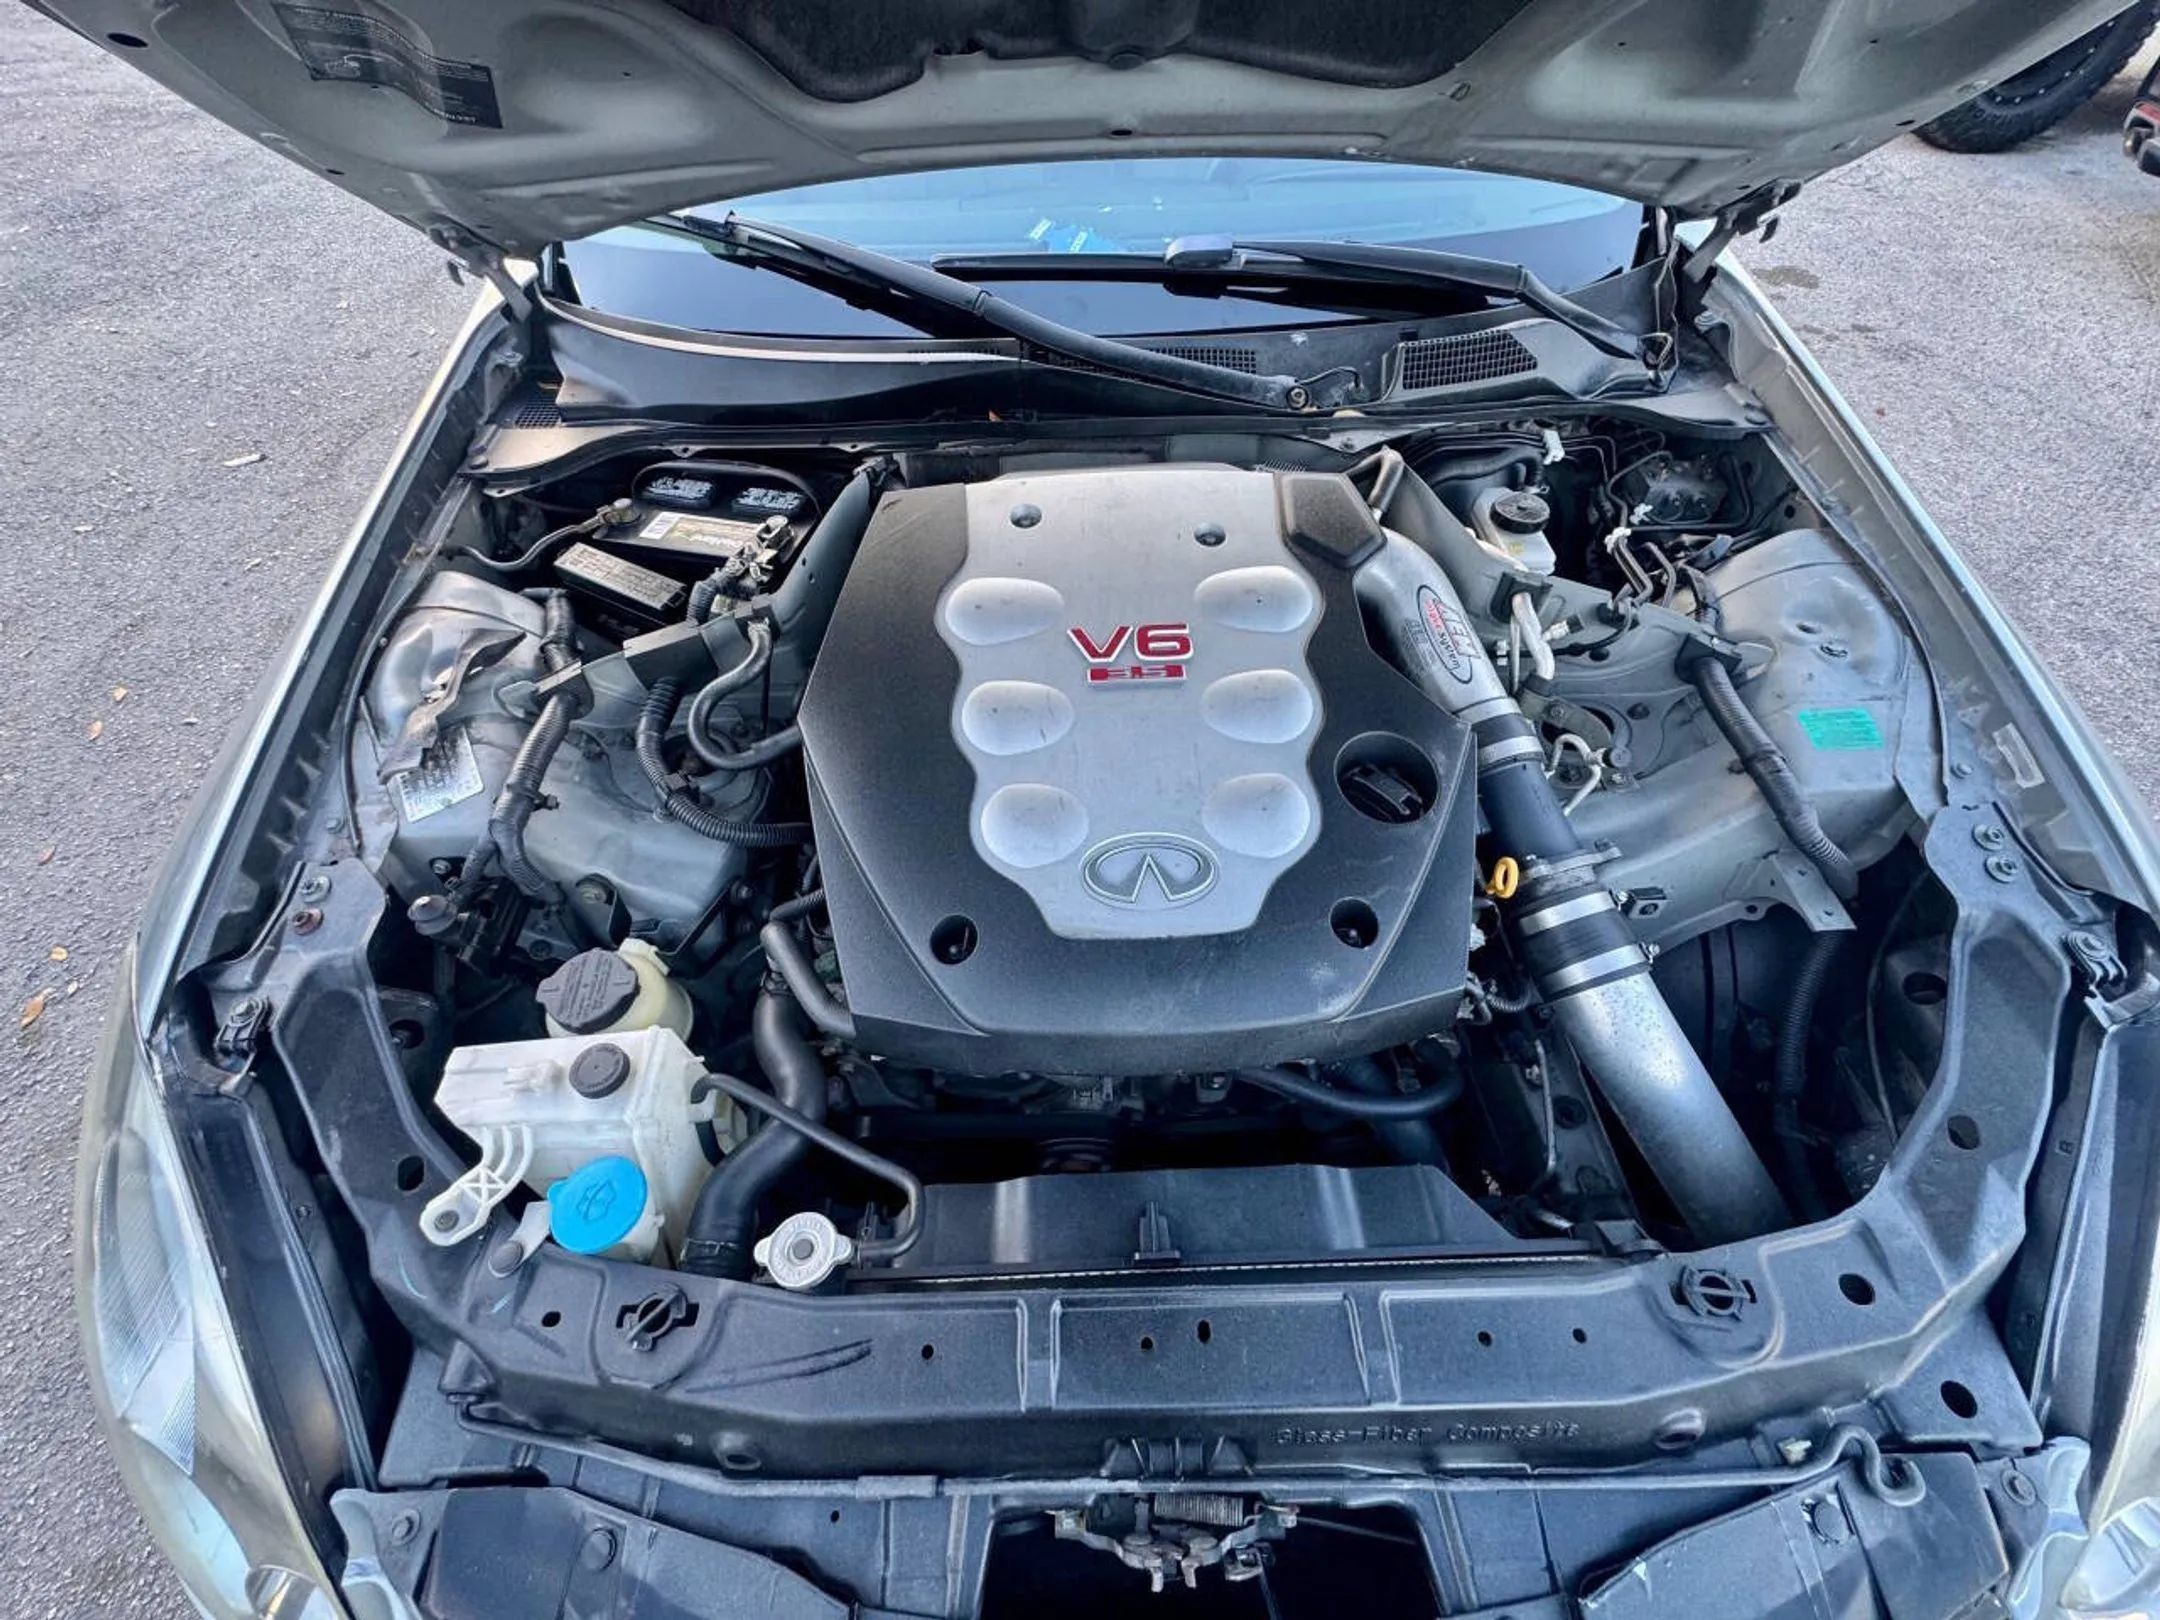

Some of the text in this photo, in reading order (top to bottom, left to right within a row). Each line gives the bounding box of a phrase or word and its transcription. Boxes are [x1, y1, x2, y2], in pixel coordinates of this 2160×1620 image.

[1066, 622, 1194, 663] V6
[1276, 1417, 1580, 1445] Glass-Fiber Composite
